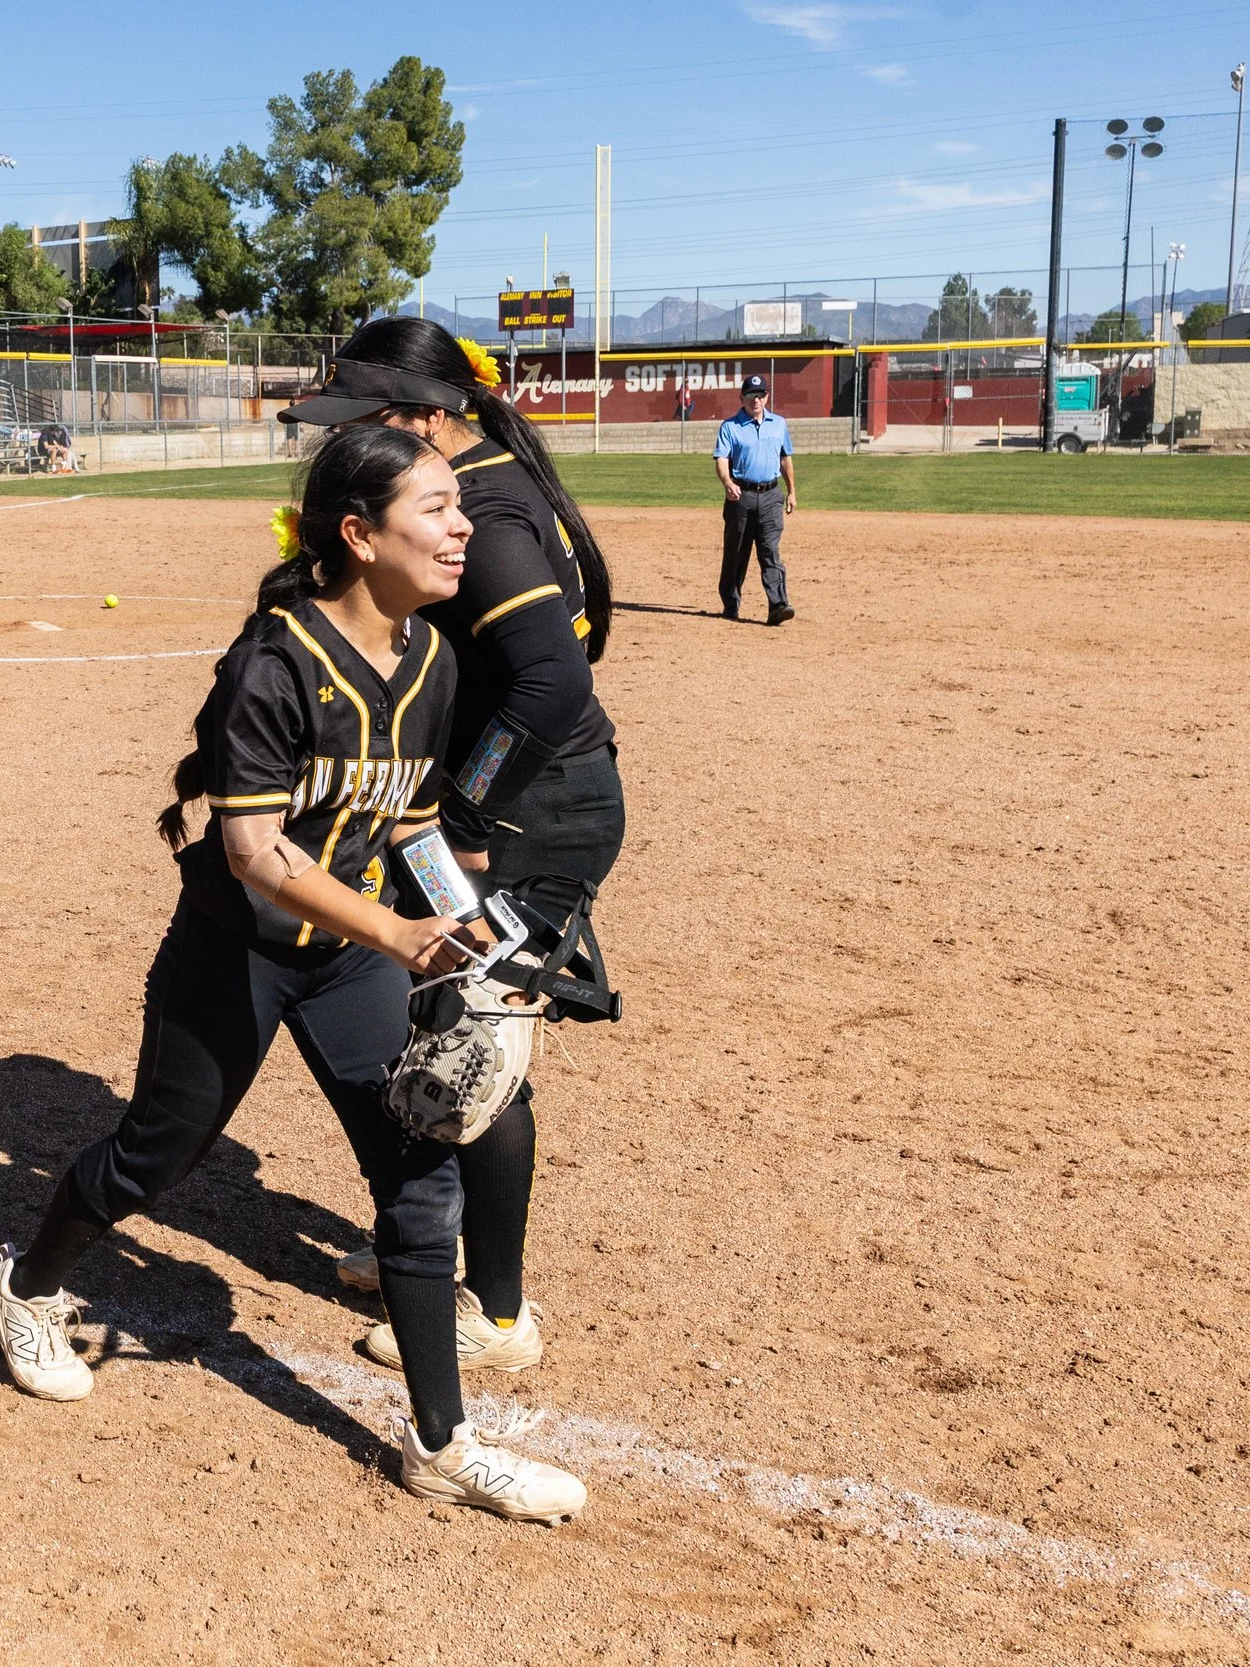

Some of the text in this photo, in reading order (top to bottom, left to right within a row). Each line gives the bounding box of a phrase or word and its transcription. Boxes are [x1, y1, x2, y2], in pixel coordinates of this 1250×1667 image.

[500, 292, 525, 301] ALEMANY
[547, 289, 572, 298] VISITOR
[504, 314, 566, 325] BALL STRIKE OUT
[503, 360, 743, 403] Alemany SOFTBALL
[552, 981, 594, 998] RIP-IT
[489, 1075, 519, 1123] A2000
